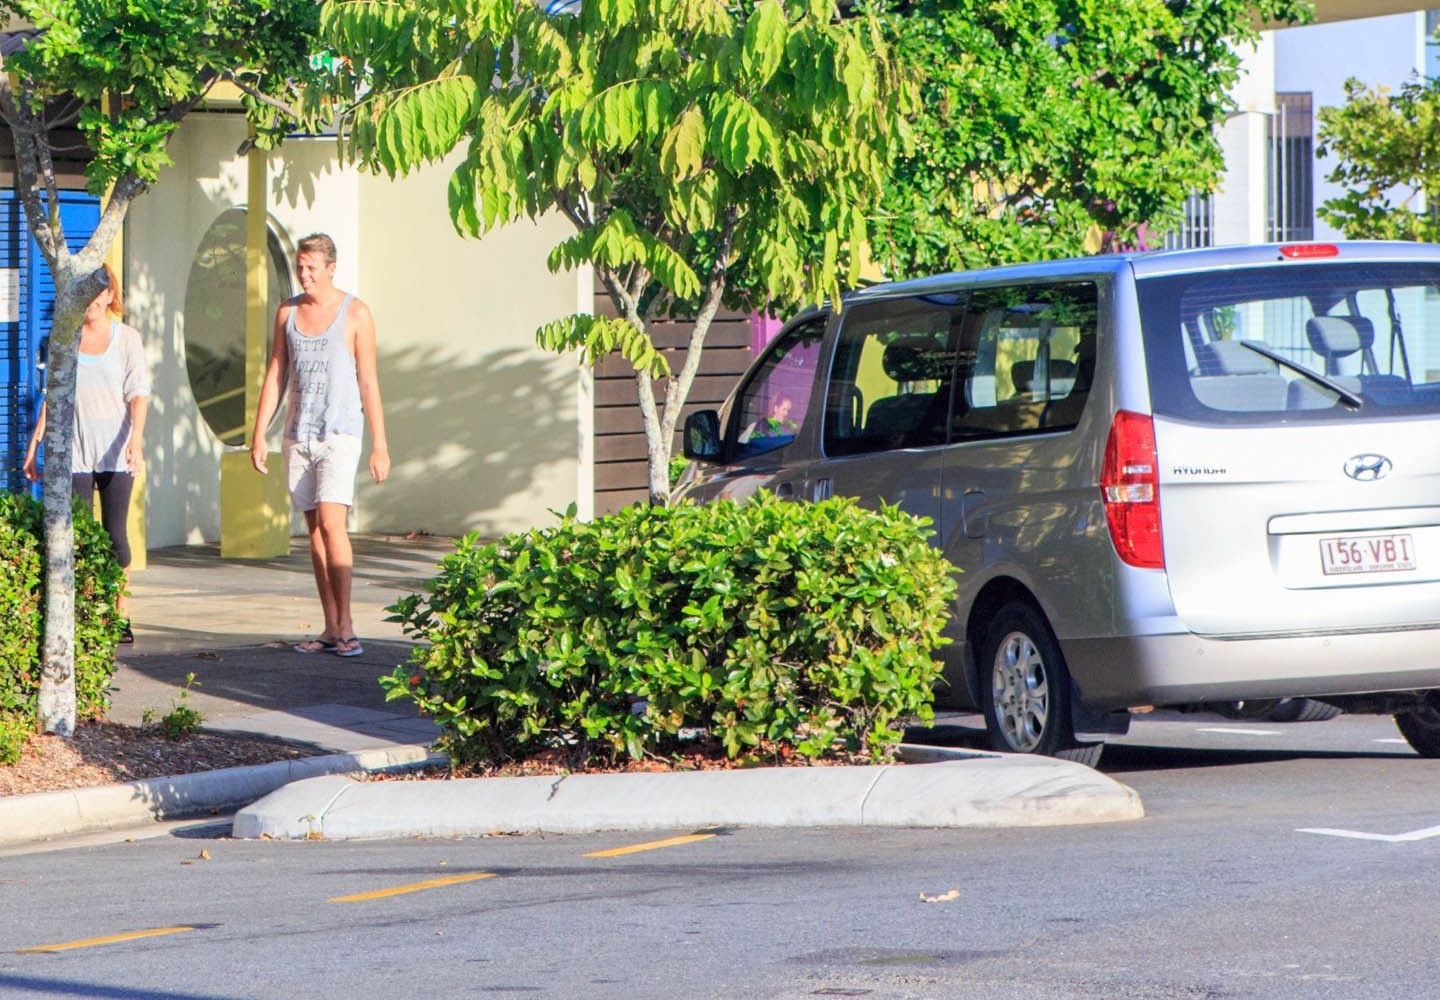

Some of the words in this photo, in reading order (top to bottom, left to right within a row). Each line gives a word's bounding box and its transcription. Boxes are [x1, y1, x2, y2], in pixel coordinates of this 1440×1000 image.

[294, 339, 329, 352] HTTP
[1327, 541, 1363, 565] 156
[1368, 538, 1409, 562] VBI
